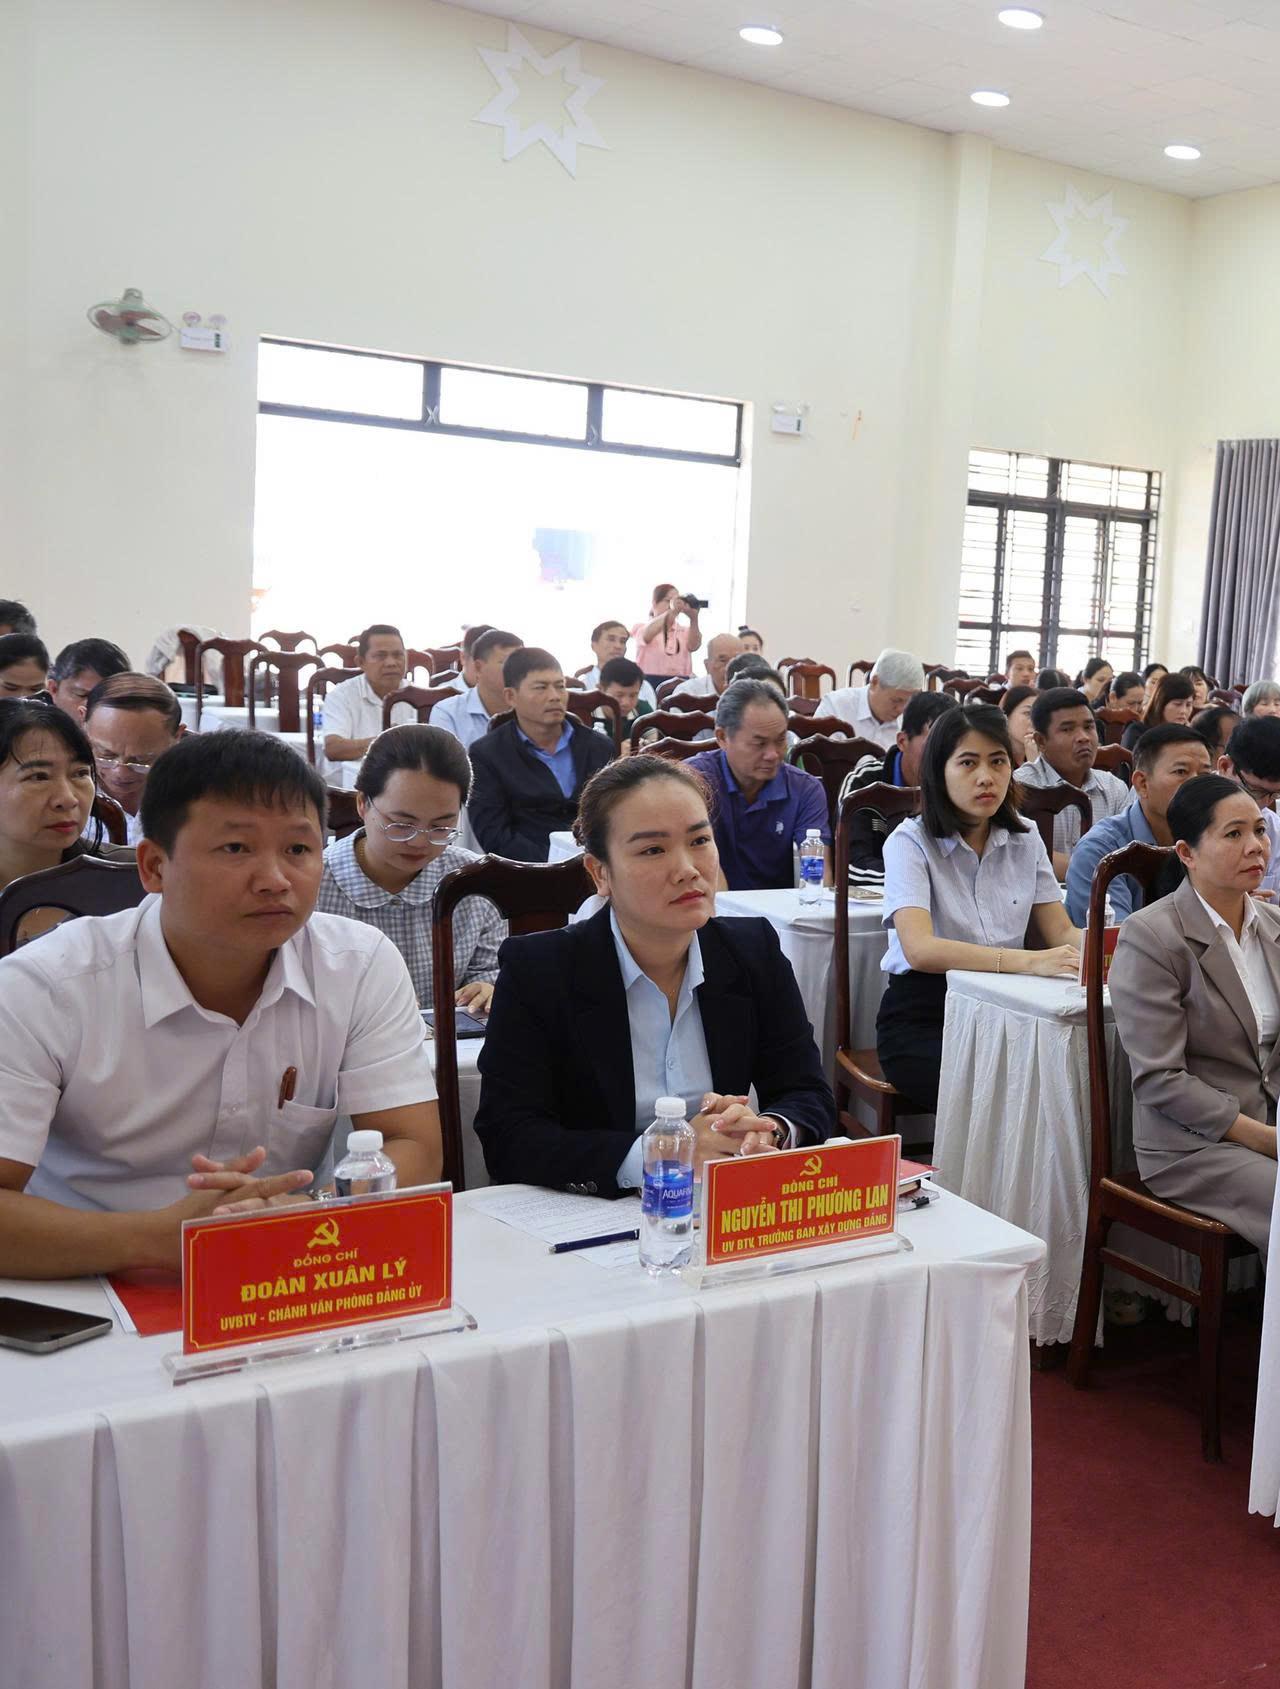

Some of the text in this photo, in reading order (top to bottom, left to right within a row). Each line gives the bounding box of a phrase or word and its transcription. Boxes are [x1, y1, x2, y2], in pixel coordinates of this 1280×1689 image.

[781, 1175, 838, 1195] ĐỒNG CHÍ
[721, 1184, 889, 1234] NGUYỄN THỊ PHƯƠNG LAN
[722, 1241, 734, 1253] UV
[797, 1227, 815, 1239] BAN
[818, 1222, 835, 1236] XÂY
[838, 1218, 861, 1234] DỰNG
[864, 1212, 887, 1227] ĐẢNG
[241, 1257, 407, 1302] ĐOÀN XUÂN LÝ
[293, 1248, 359, 1268] ĐỒNG CHÍ
[220, 1313, 257, 1331] UVBTV
[268, 1304, 307, 1322] CHÁNH
[310, 1299, 333, 1315] VĂN
[336, 1294, 373, 1312] PHÒNG
[376, 1286, 406, 1303] ĐẢNG
[408, 1281, 422, 1298] ỦY
